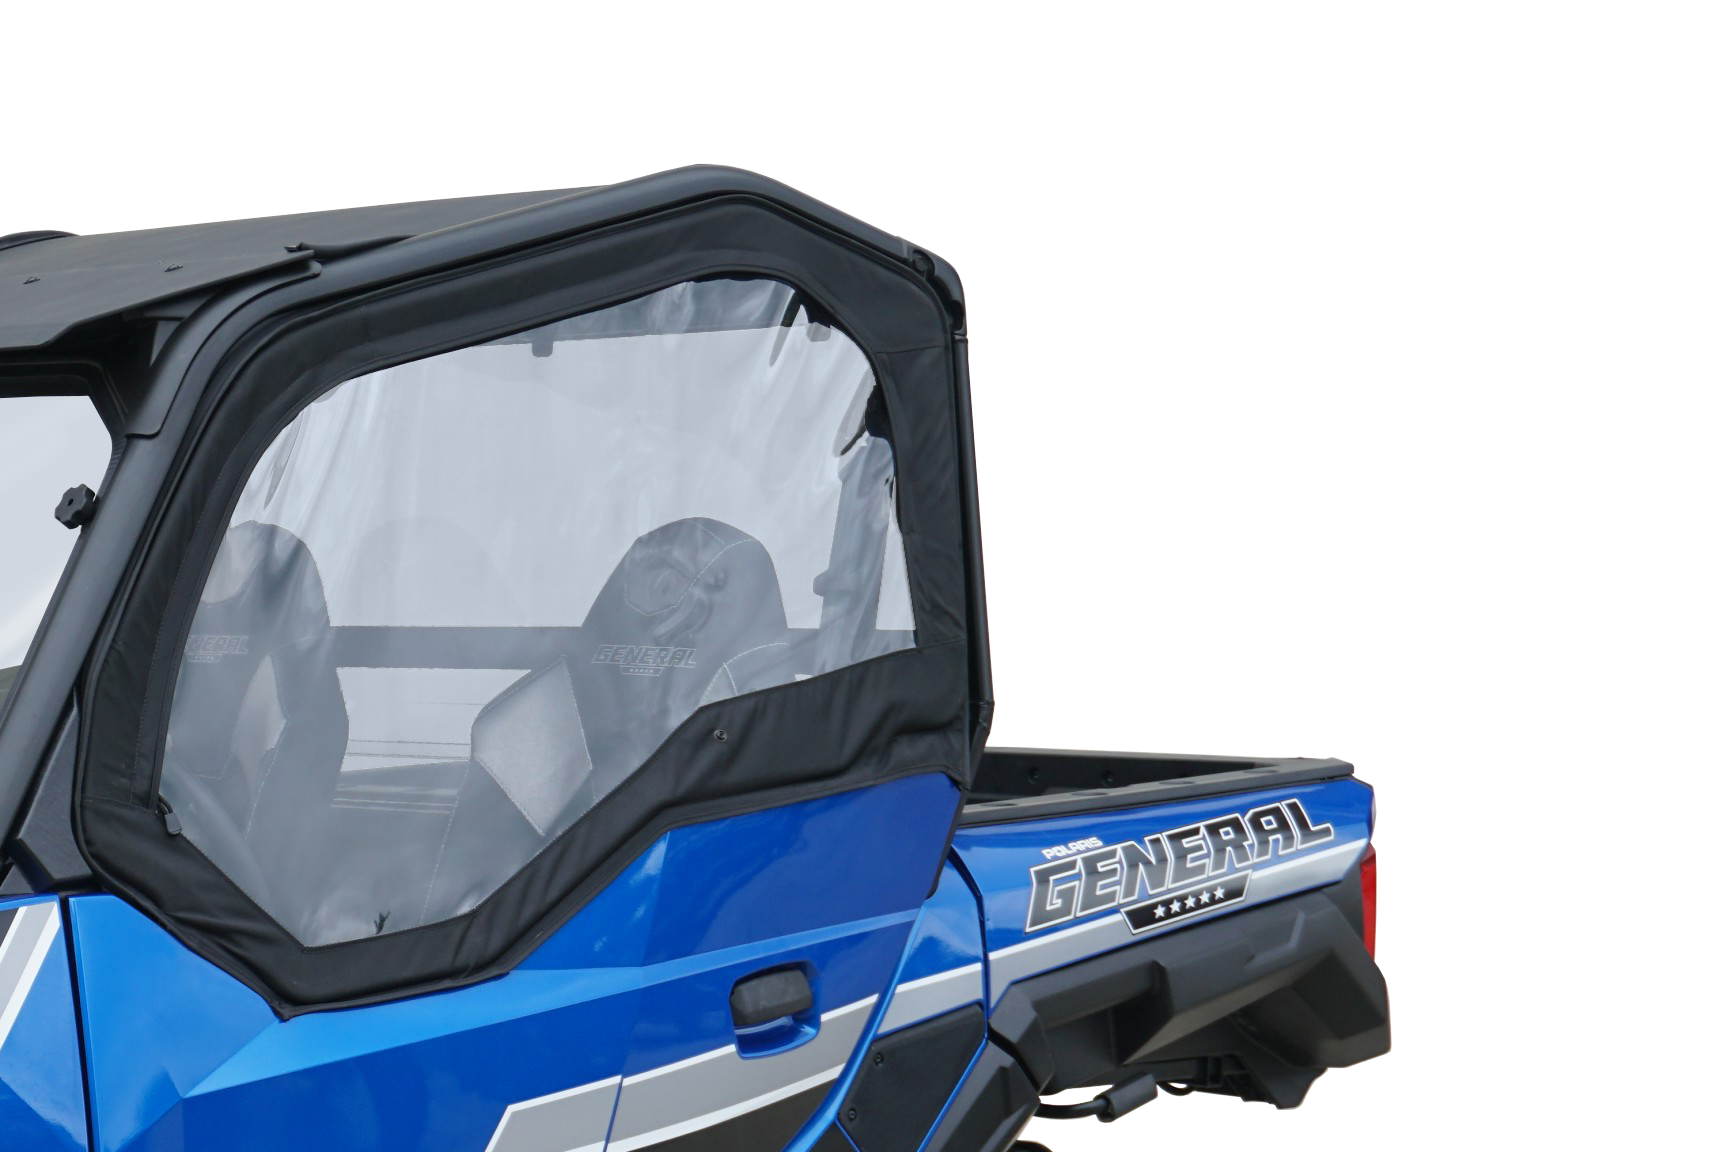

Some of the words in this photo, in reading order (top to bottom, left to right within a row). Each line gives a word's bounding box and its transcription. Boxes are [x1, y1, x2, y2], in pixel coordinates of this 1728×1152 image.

[591, 643, 697, 669] GENERAL
[1041, 837, 1103, 860] POLARIS
[1024, 797, 1335, 934] GENERAL
